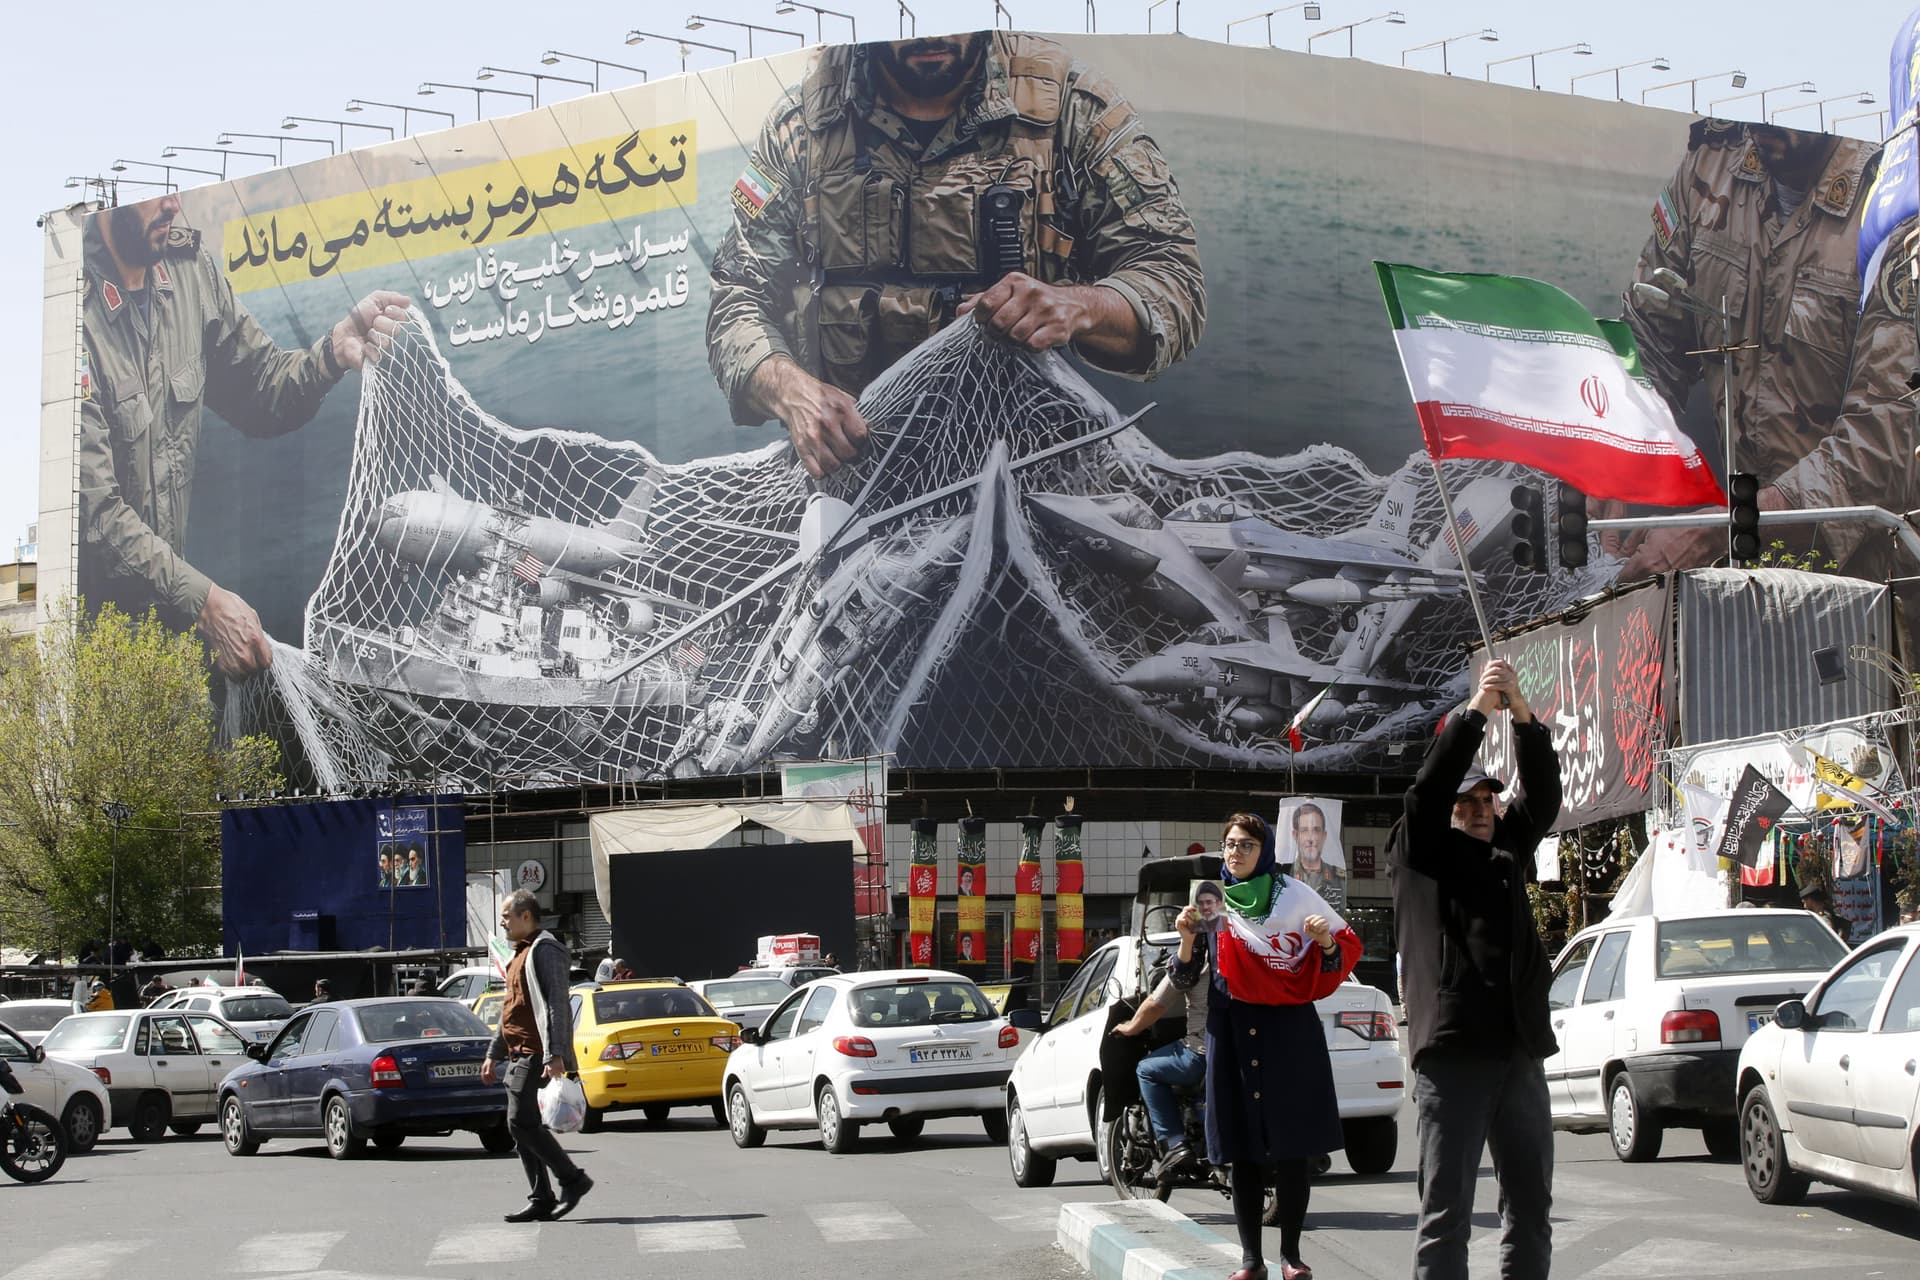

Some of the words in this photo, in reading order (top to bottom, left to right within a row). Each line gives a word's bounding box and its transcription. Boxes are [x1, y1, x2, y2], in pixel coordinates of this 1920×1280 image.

[585, 130, 687, 195] تنگه
[373, 195, 474, 241] بسته
[472, 163, 580, 244] هرمز
[499, 238, 581, 300] خلیج
[577, 224, 689, 282] سراسر
[450, 300, 530, 346] ماست
[527, 284, 610, 344] شکار
[607, 263, 689, 330] قلمرو
[1387, 499, 1404, 518] SW
[1181, 656, 1199, 668] 302
